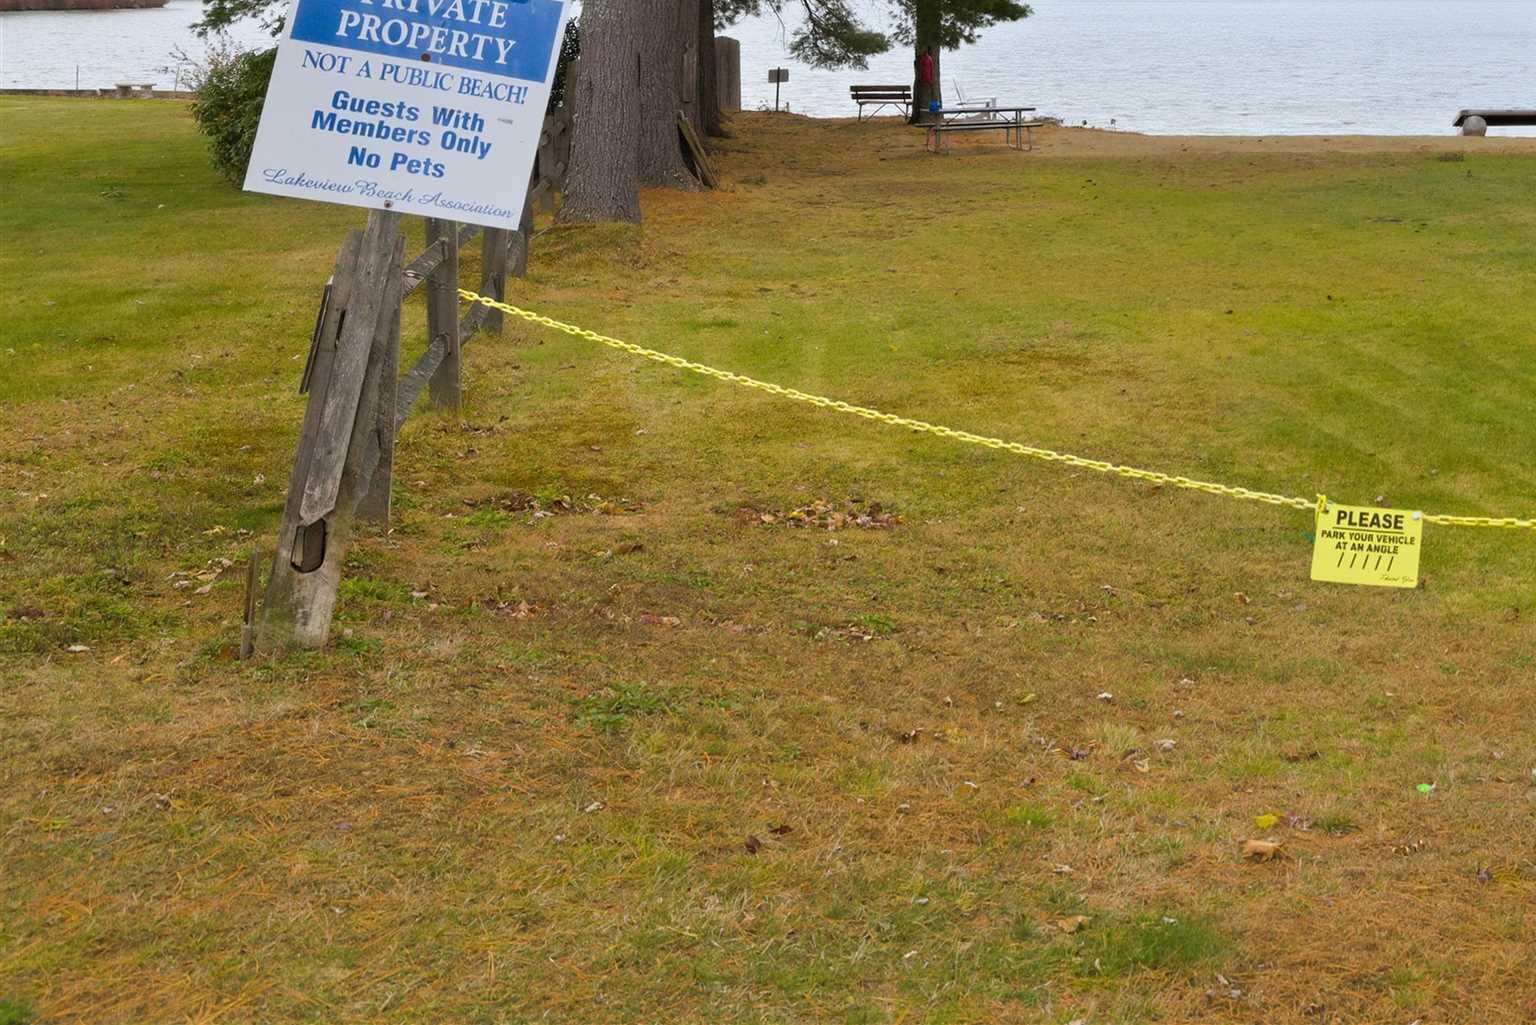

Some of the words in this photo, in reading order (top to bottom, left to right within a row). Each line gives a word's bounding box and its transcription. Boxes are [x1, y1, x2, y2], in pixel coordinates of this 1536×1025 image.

[336, 9, 517, 65] PROPERTY
[301, 49, 352, 74] NOT
[355, 61, 373, 78] A
[380, 64, 452, 92] PUBLIC
[458, 76, 528, 105] BEACH!
[331, 90, 420, 122] Guests
[432, 106, 485, 132] With
[311, 110, 432, 147] Members
[440, 131, 492, 160] Only
[347, 146, 381, 169] No
[390, 152, 446, 178] Pets
[263, 168, 353, 193] Lakeview
[355, 179, 415, 203] Beach
[418, 192, 514, 218] Association
[1321, 529, 1345, 540] PARK
[1349, 531, 1374, 543] YOUR
[1376, 534, 1416, 546] VEHICLE
[1336, 510, 1405, 530] PLEASE
[1335, 541, 1348, 550] AT
[1350, 543, 1364, 552] AN
[1366, 544, 1399, 555] ANGLE
